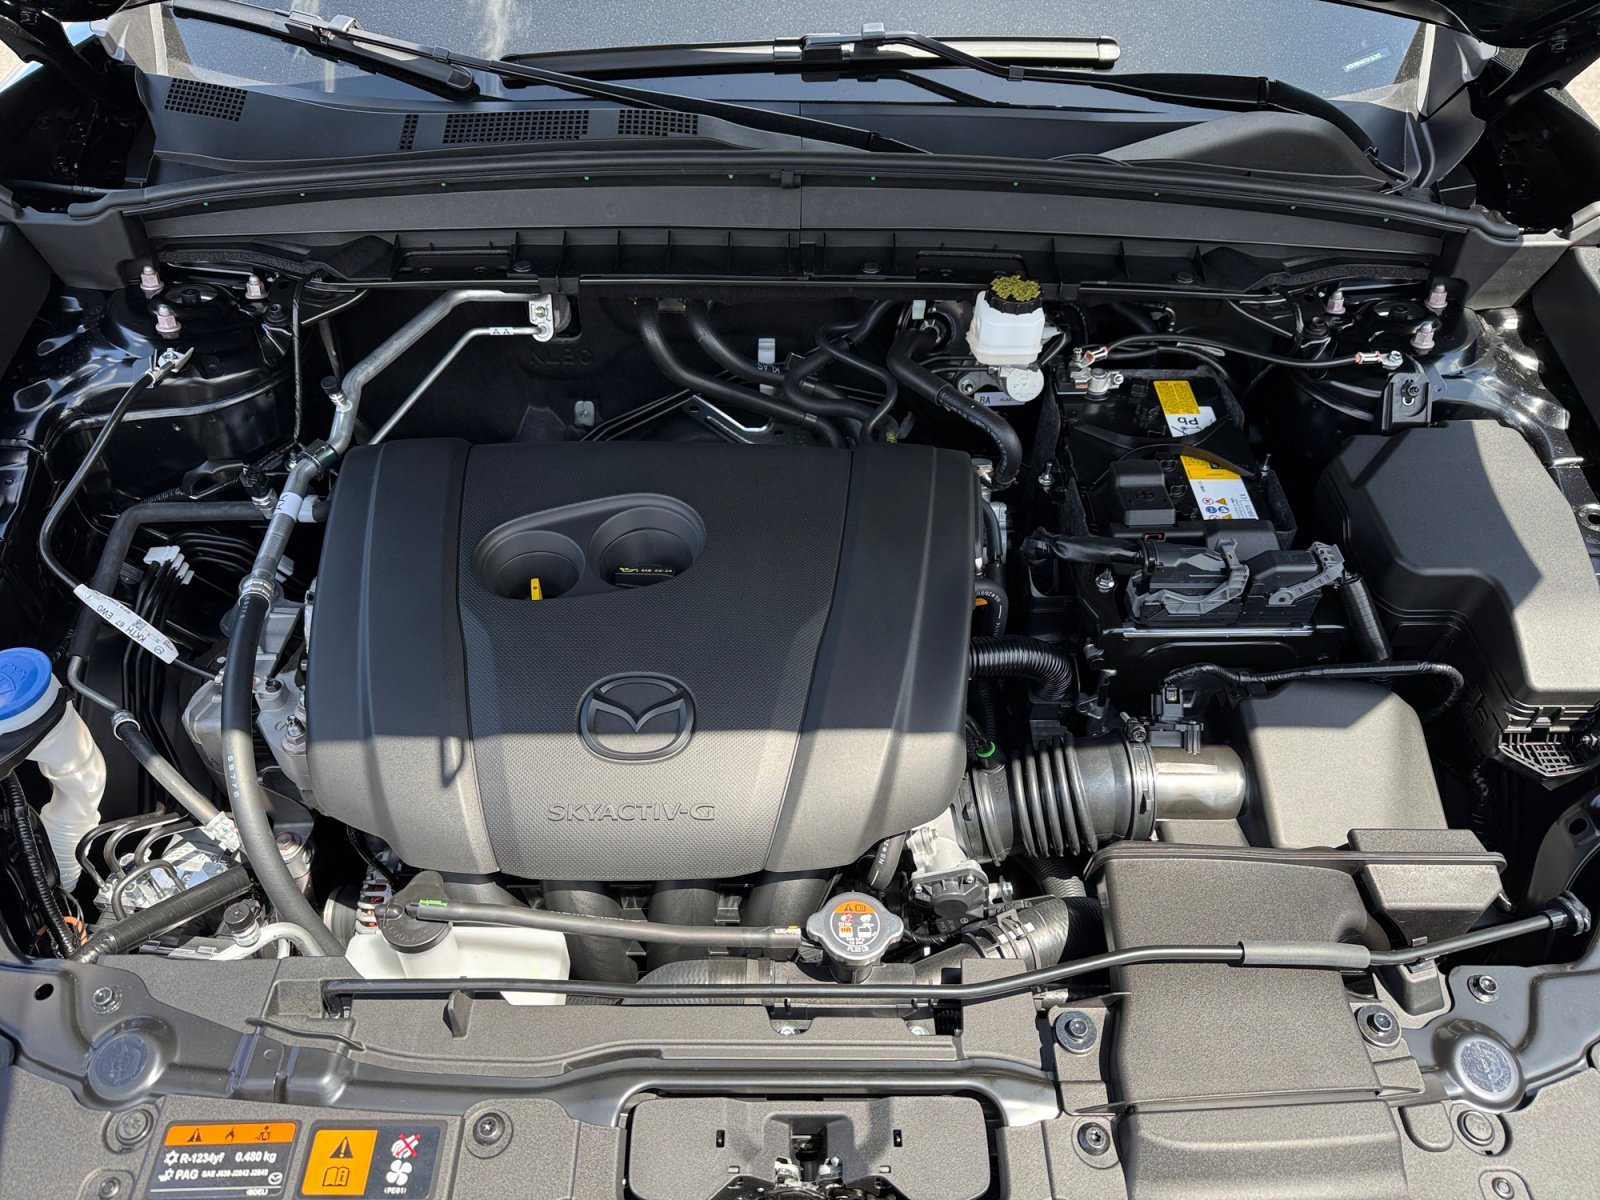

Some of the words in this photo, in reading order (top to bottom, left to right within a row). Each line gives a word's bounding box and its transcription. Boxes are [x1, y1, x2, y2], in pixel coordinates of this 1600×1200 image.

[548, 803, 715, 821] SKYACTIV-G
[179, 1152, 225, 1165] R-1234yf
[263, 1151, 277, 1164] kg
[174, 1168, 199, 1180] PAG
